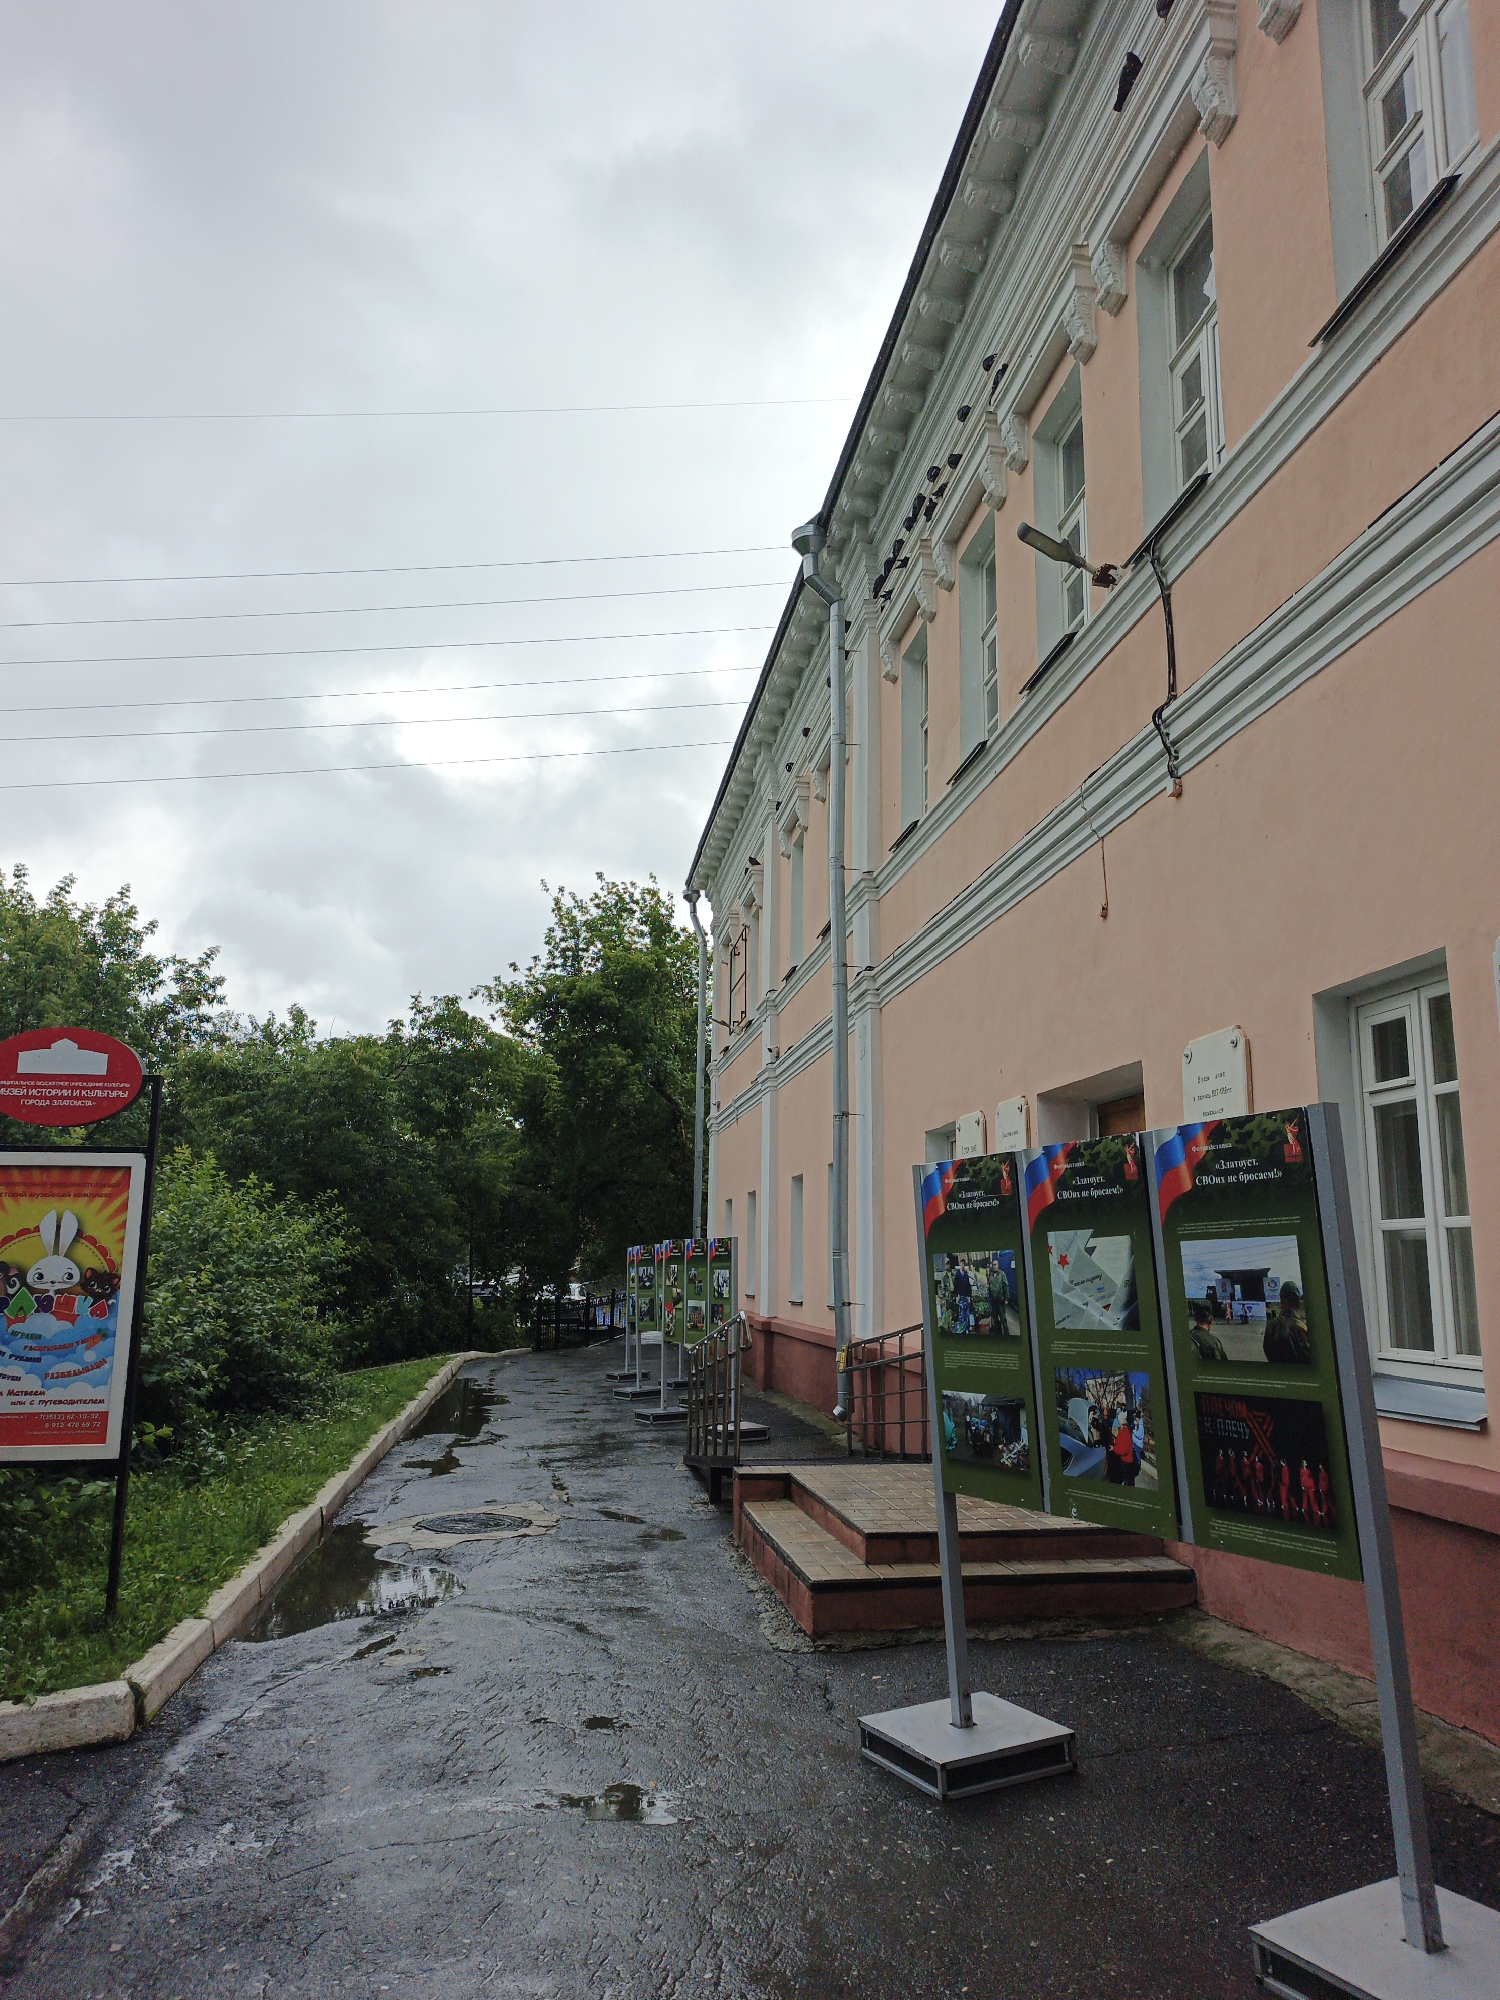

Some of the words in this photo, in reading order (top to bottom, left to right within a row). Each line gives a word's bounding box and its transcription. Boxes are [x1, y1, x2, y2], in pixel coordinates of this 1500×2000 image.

[28, 1088, 72, 1097] ИСТОРИИ
[73, 1089, 80, 1097] И
[81, 1089, 129, 1098] КУЛЬТУРЫ
[1195, 1174, 1225, 1186] СВОих
[1227, 1174, 1237, 1183] не
[1239, 1168, 1283, 1184] бросаем!»
[1056, 1189, 1080, 1200] СВОих
[1081, 1188, 1090, 1197] не
[6, 1388, 46, 1397] Матвеем
[38, 1398, 105, 1407] путеводителем
[51, 1421, 65, 1429] 912
[1216, 1418, 1250, 1440] ПЛЕЧУ
